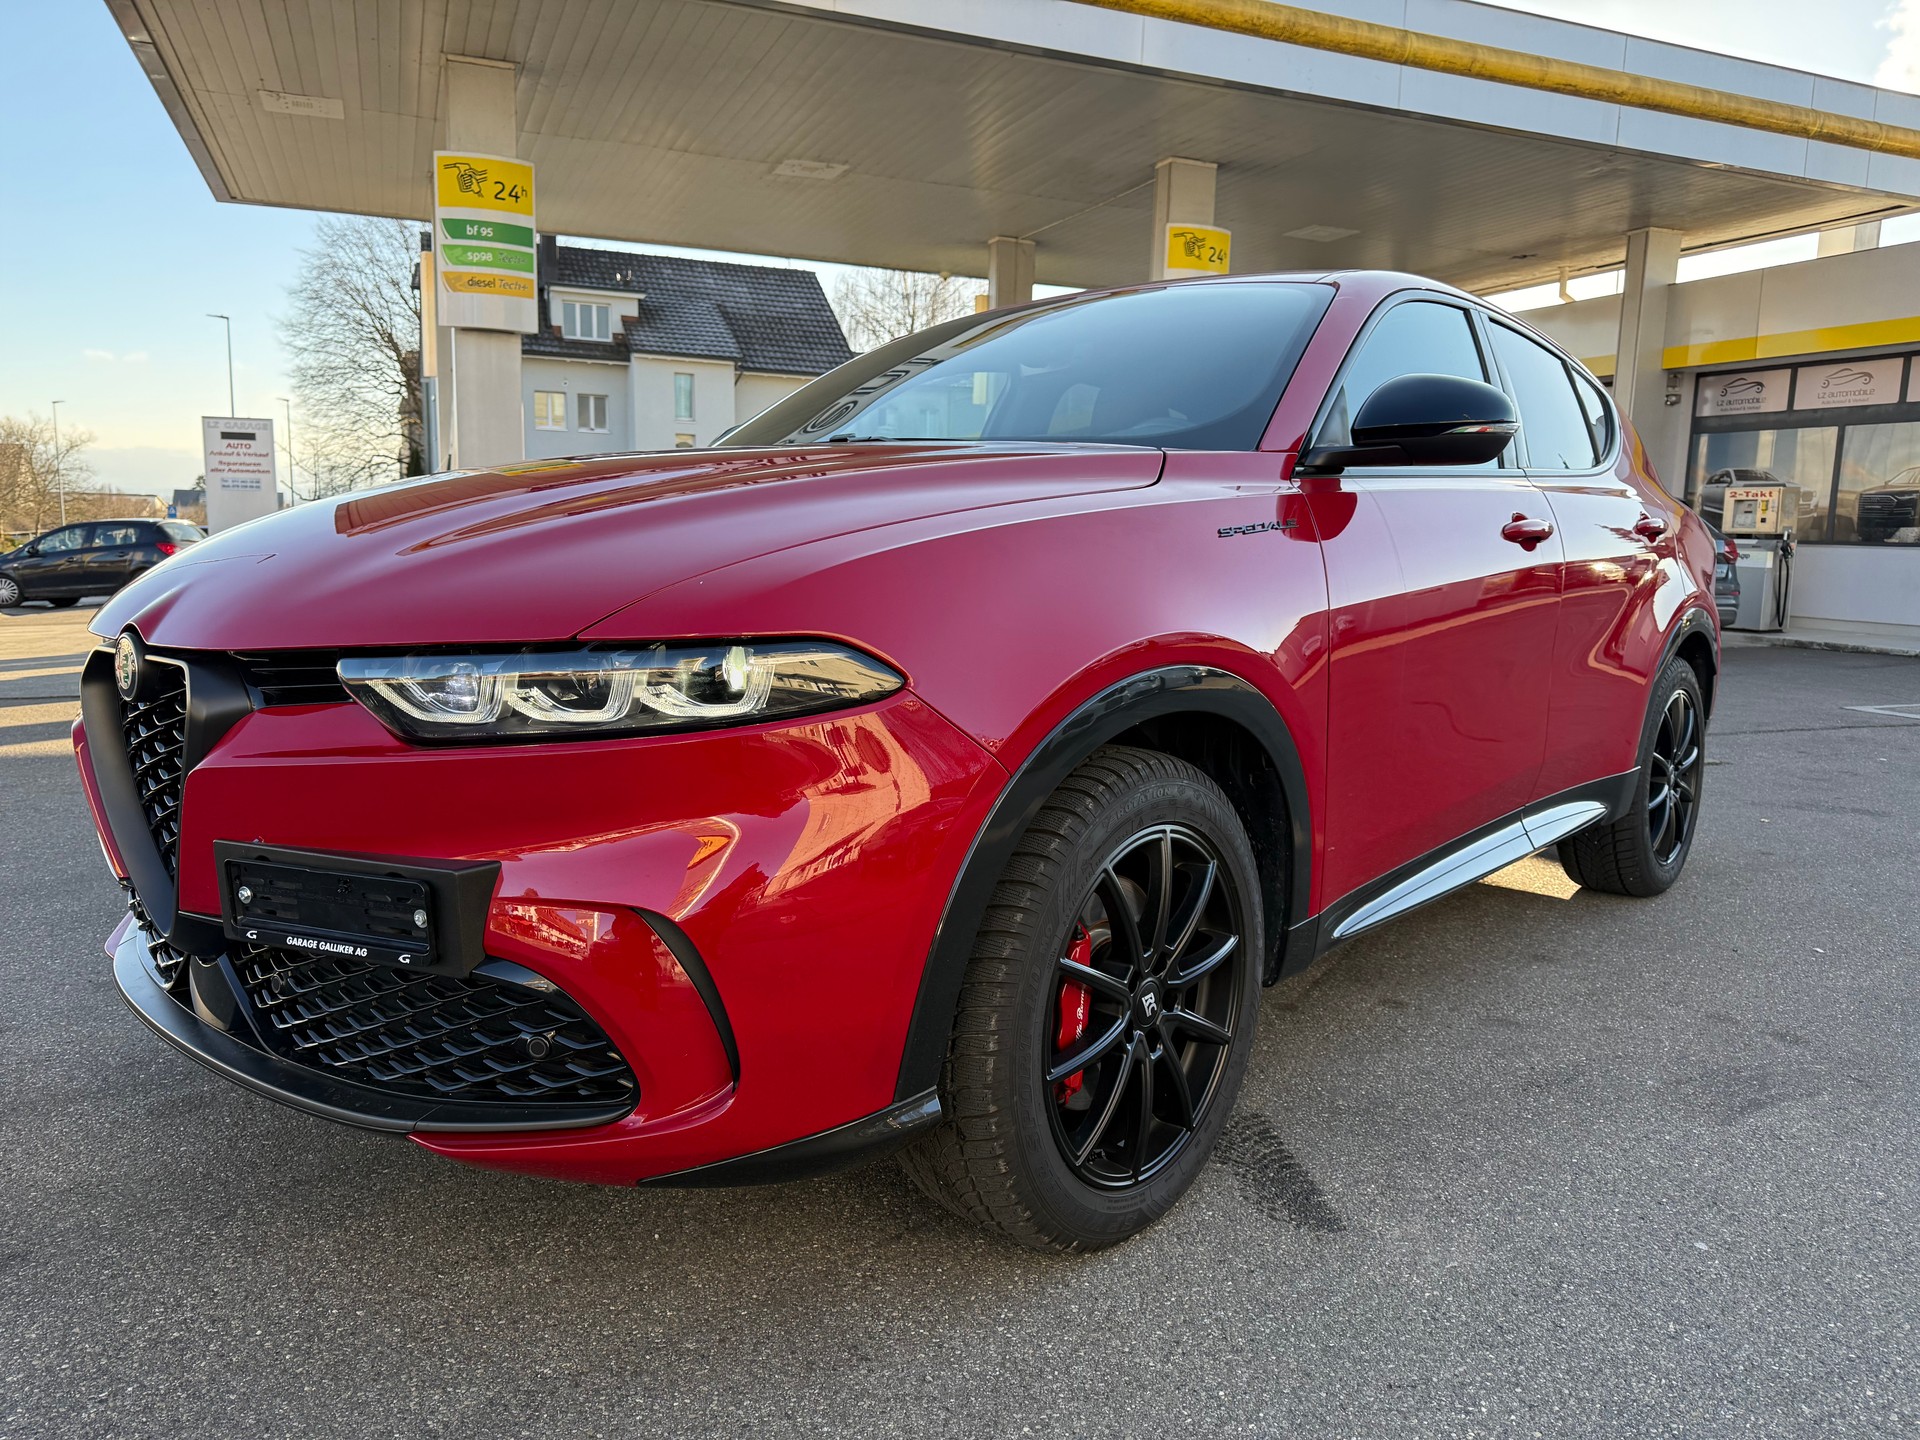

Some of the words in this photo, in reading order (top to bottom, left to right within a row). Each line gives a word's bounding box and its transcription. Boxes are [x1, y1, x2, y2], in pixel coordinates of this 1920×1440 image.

[493, 181, 528, 204] 24h
[466, 224, 479, 236] bf
[480, 226, 494, 237] 95
[466, 250, 493, 263] sp98
[467, 276, 496, 289] diesel
[224, 421, 269, 431] GARAGE
[225, 442, 252, 450] AUTO
[1729, 490, 1774, 498] 2-Takt
[286, 936, 318, 950] GARAGE
[319, 941, 354, 955] GALLIKER
[354, 946, 368, 957] AG
